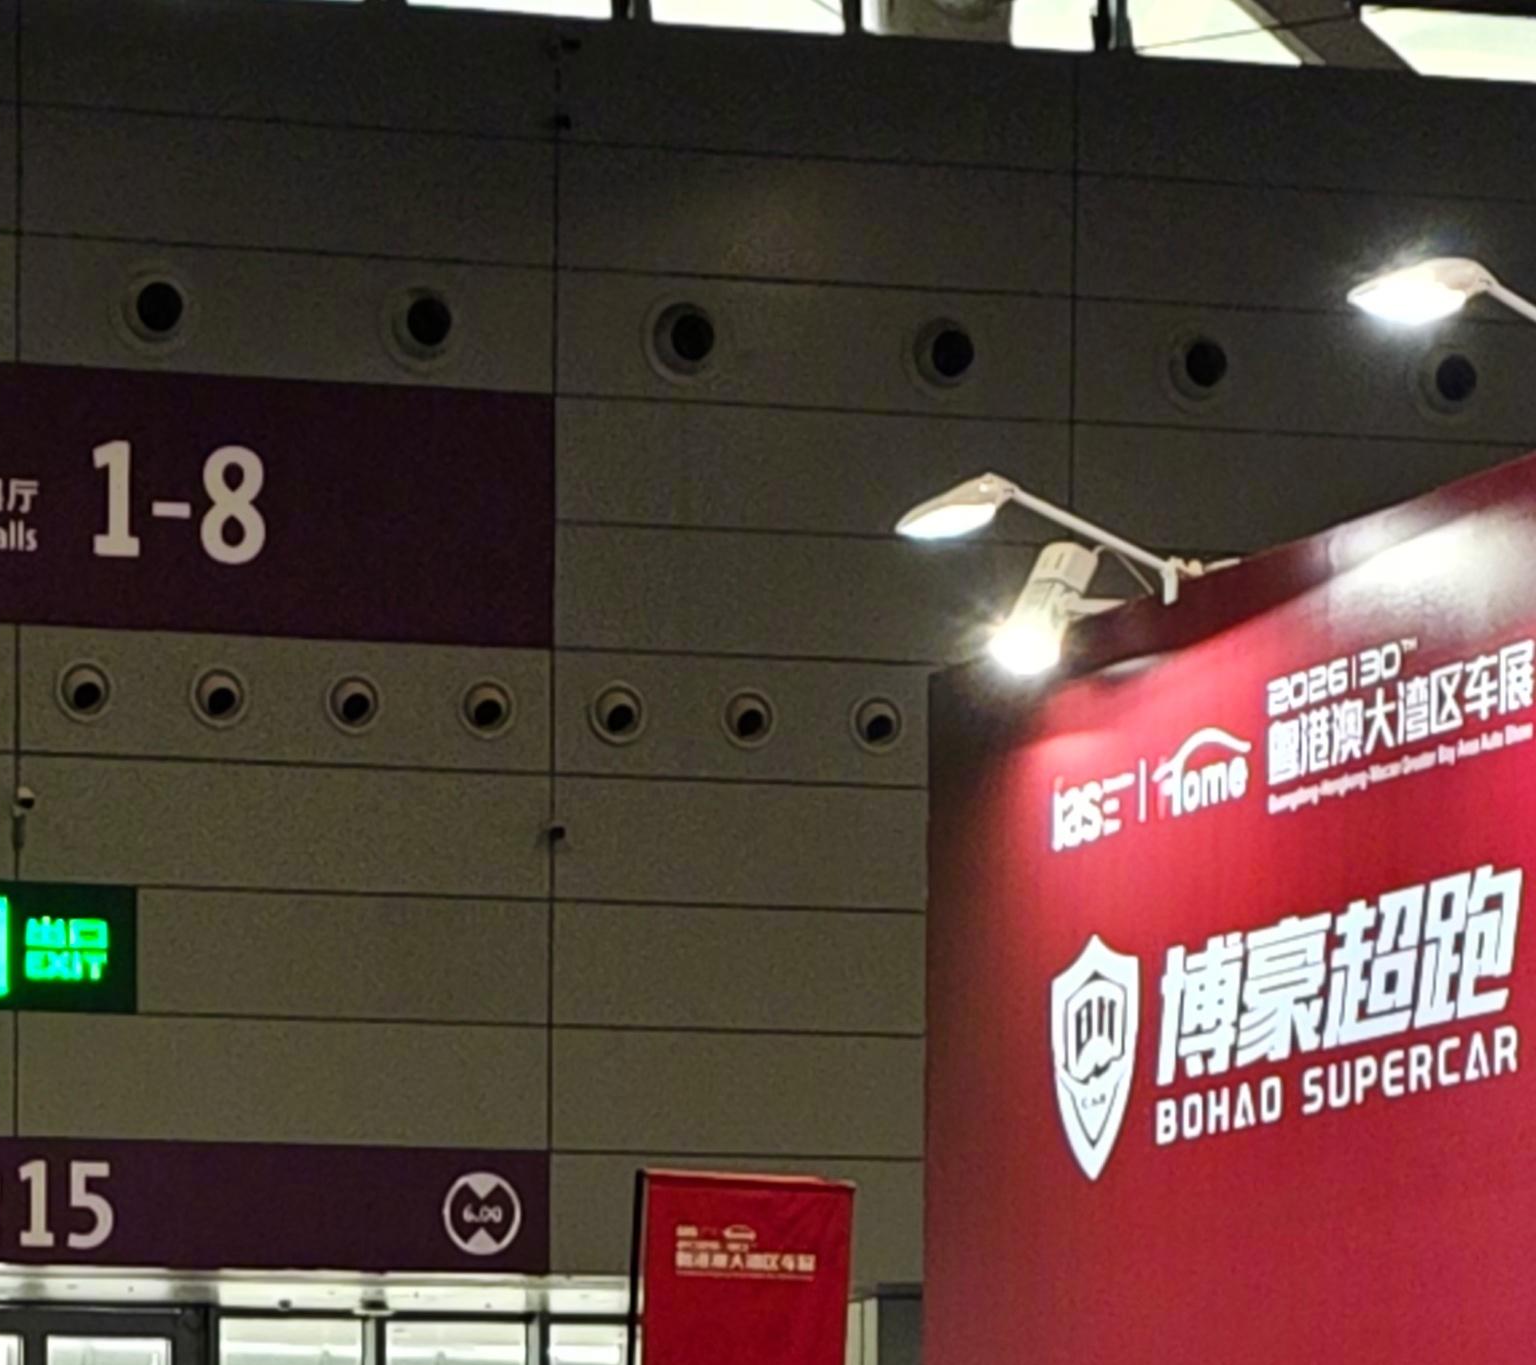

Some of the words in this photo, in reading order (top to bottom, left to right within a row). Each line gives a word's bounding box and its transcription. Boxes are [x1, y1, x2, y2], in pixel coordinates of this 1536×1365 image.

[92, 439, 266, 564] 1-8
[1267, 639, 1535, 786] 粤港澳大湾区车展
[25, 950, 108, 981] EXIT
[1156, 864, 1523, 1086] 博豪超跑
[1155, 1076, 1282, 1146] BOHAO
[1301, 1025, 1518, 1115] SUPERCAR
[18, 1159, 113, 1249] 15
